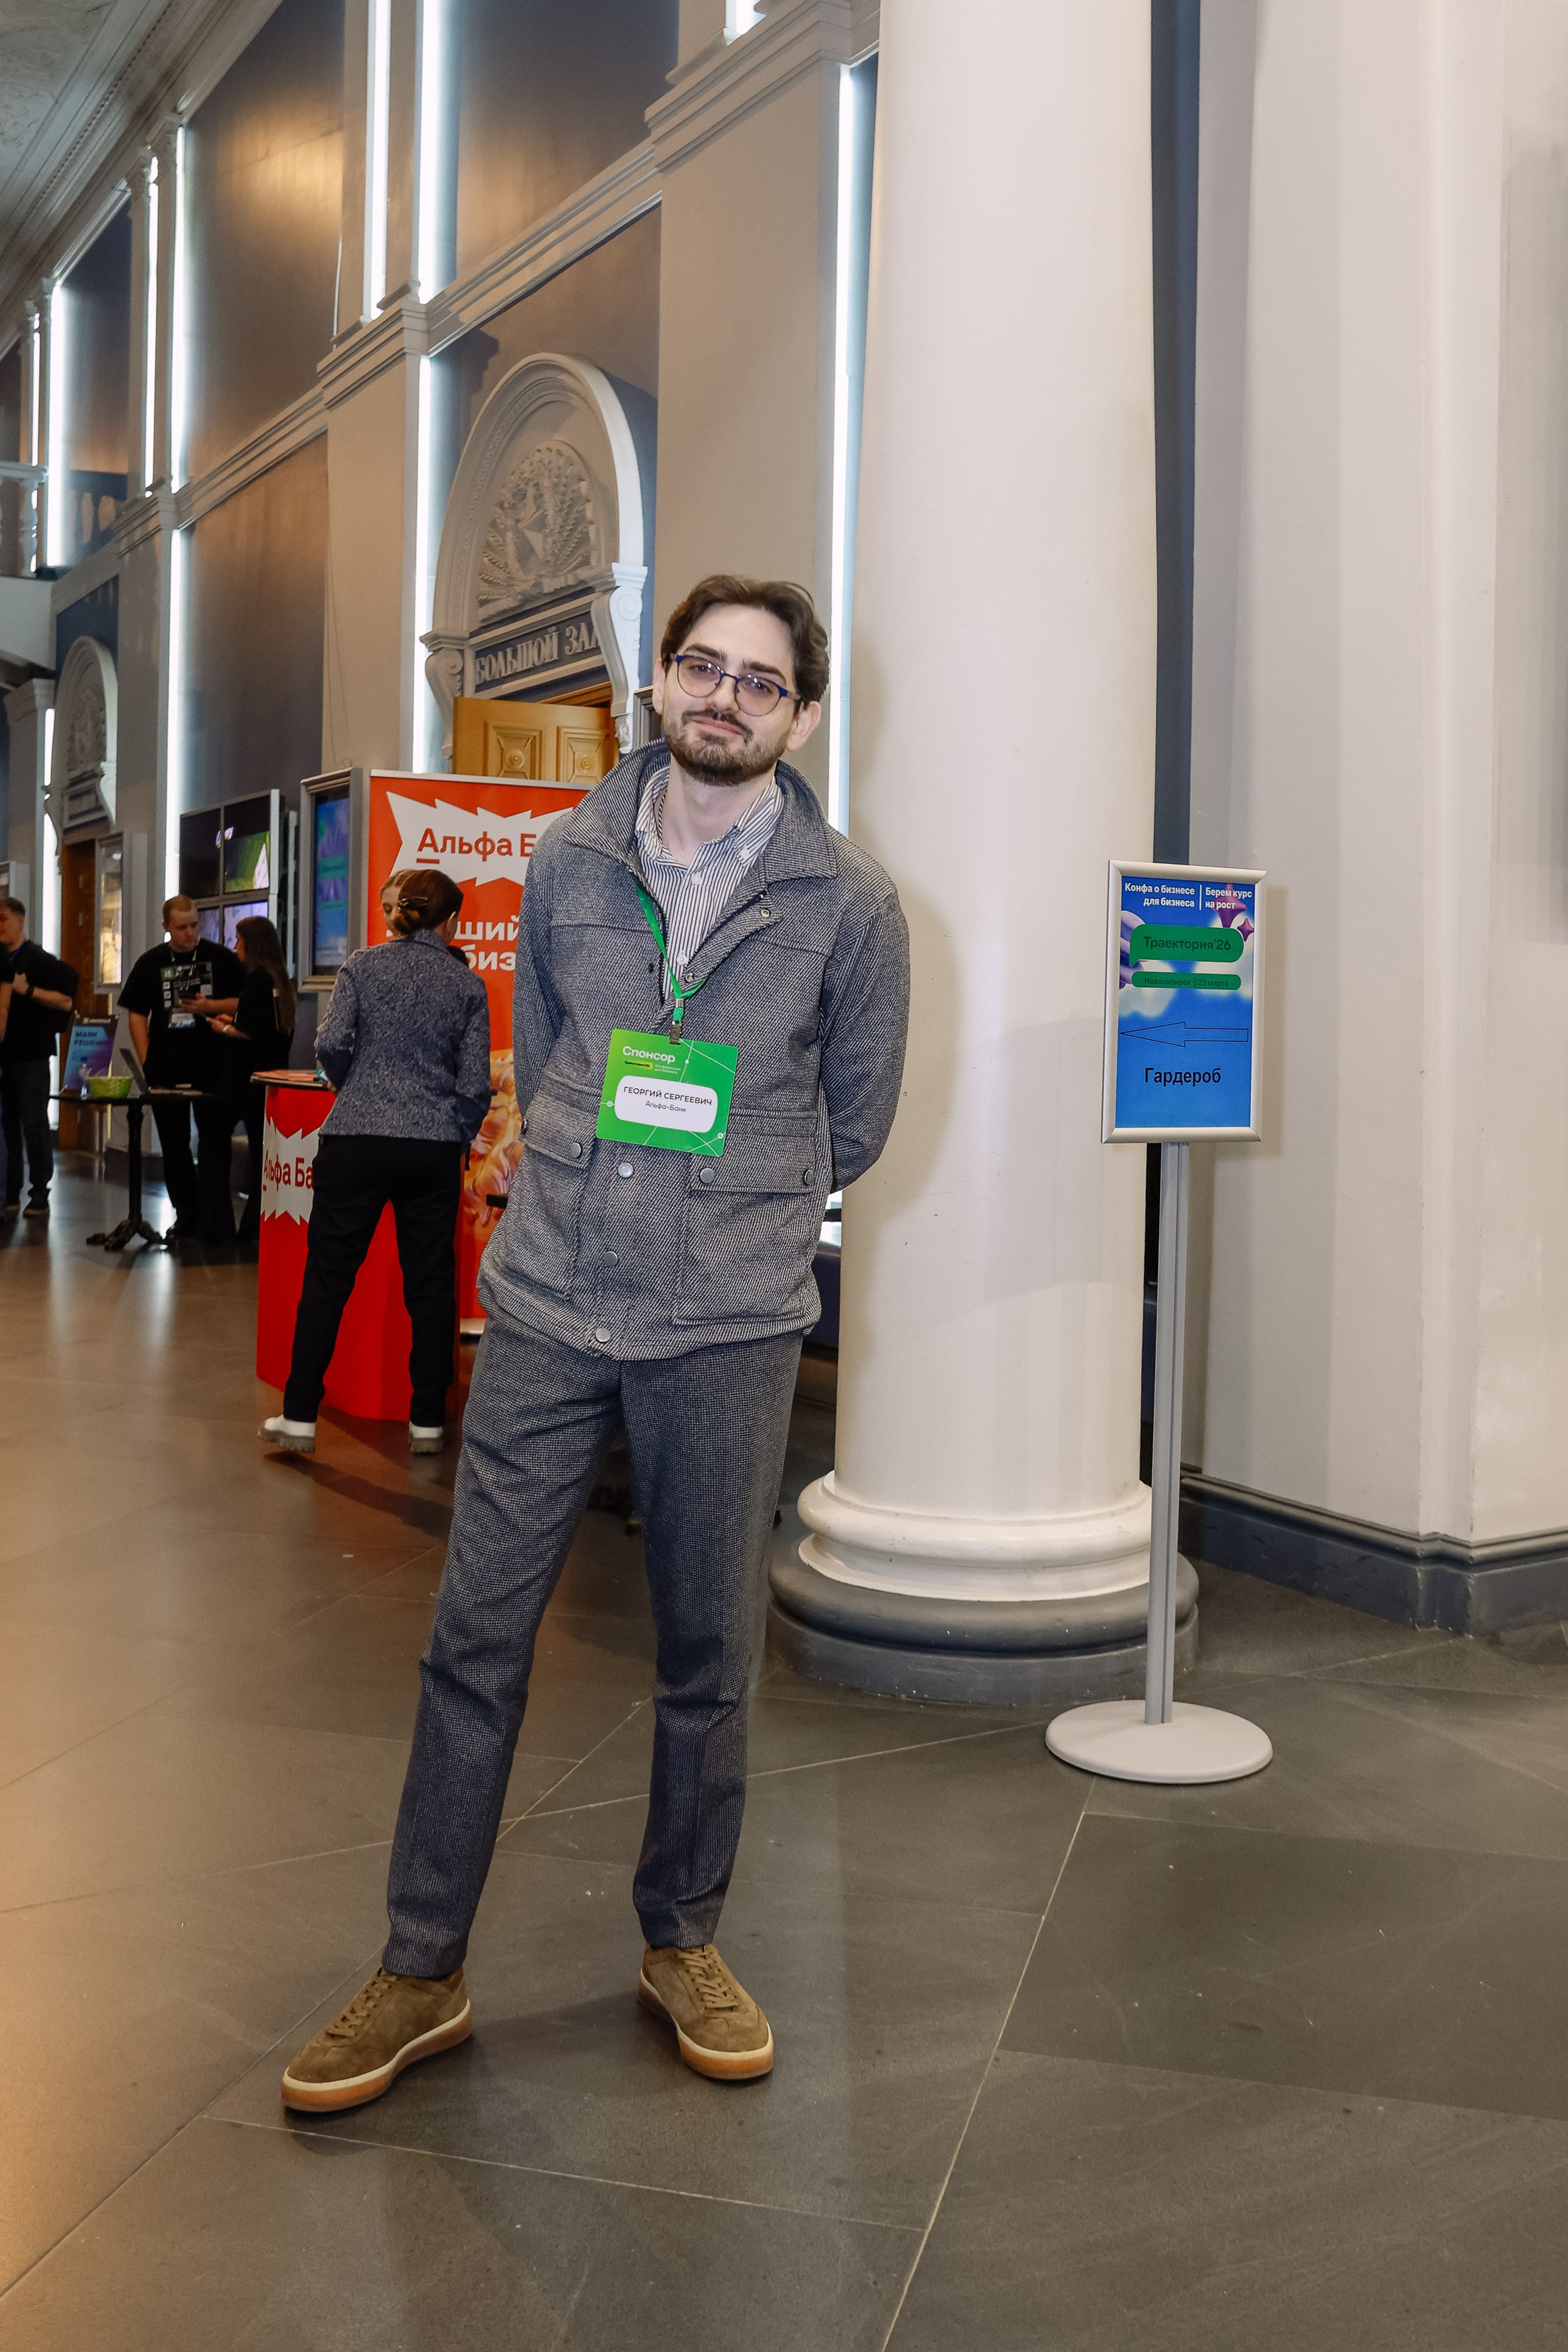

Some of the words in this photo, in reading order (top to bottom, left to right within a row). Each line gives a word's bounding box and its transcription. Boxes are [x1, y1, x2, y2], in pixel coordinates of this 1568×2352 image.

[475, 626, 559, 685] БОЛЬШОЙ
[417, 827, 512, 863] Альфа
[1125, 882, 1152, 894] Конфа
[1160, 884, 1195, 895] бизнесе
[1205, 887, 1232, 898] Берем
[1233, 889, 1252, 899] курс
[1143, 897, 1160, 907] для
[1160, 897, 1195, 907] бизнеса
[1216, 902, 1236, 910] рост
[455, 915, 520, 941] ший
[1143, 936, 1231, 951] Траектория'26
[460, 944, 517, 971] биз
[1145, 977, 1191, 987] Новосибирск
[622, 1045, 676, 1064] Спонсор
[1145, 1067, 1222, 1087] Гардероб
[623, 1086, 662, 1098] ГЕОРГИЙ
[664, 1092, 713, 1105] СЕРГЕЕВИЧ
[645, 1100, 687, 1113] Альфа-Банк
[263, 1149, 292, 1192] Альфа
[294, 1157, 314, 1190] Ба
